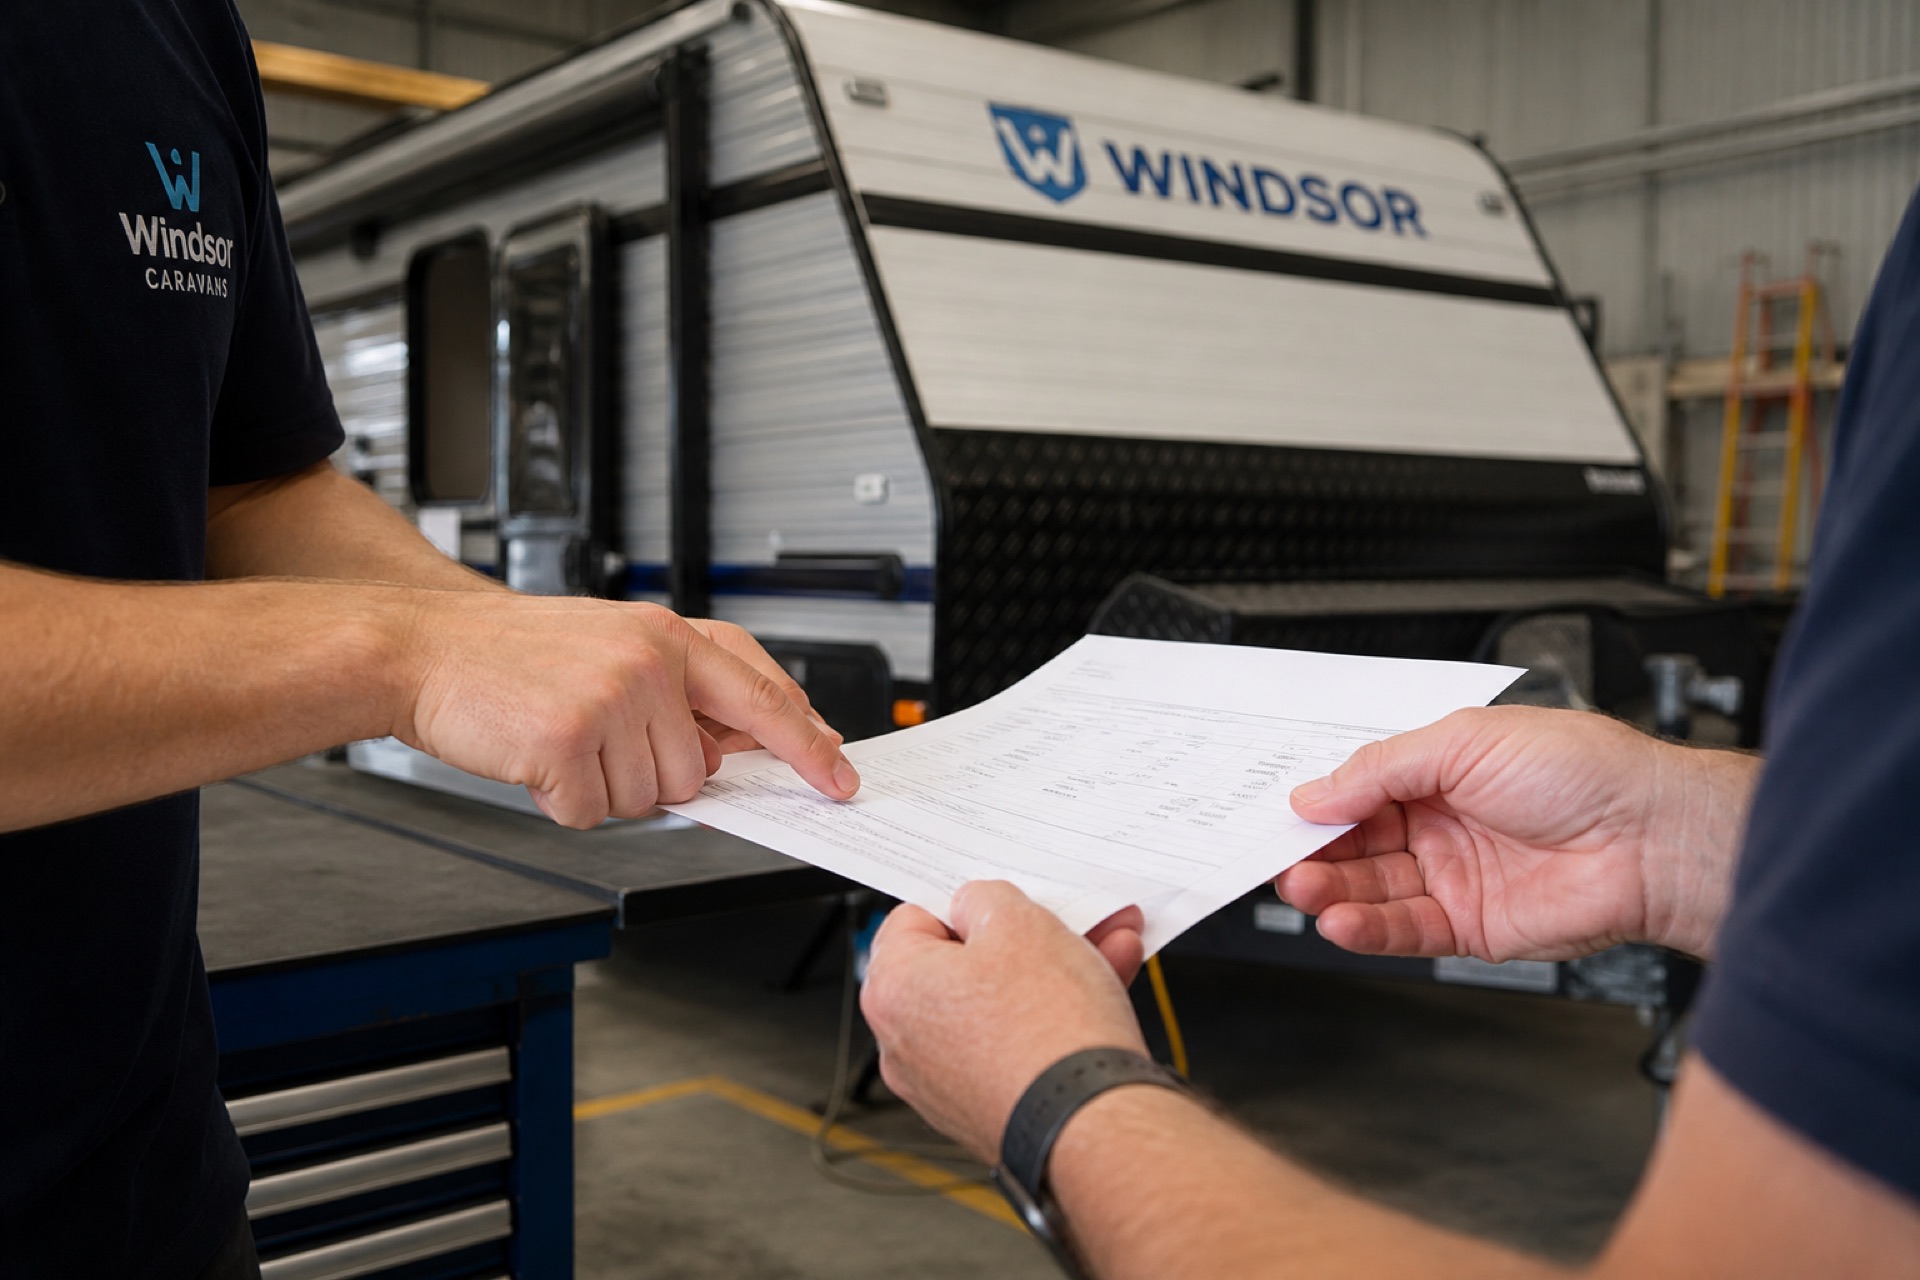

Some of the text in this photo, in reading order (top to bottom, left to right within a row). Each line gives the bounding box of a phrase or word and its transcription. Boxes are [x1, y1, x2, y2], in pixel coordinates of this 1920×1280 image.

[1102, 138, 1428, 239] WINDSOR
[119, 212, 233, 269] Windsor
[145, 267, 228, 298] CARAVANS
